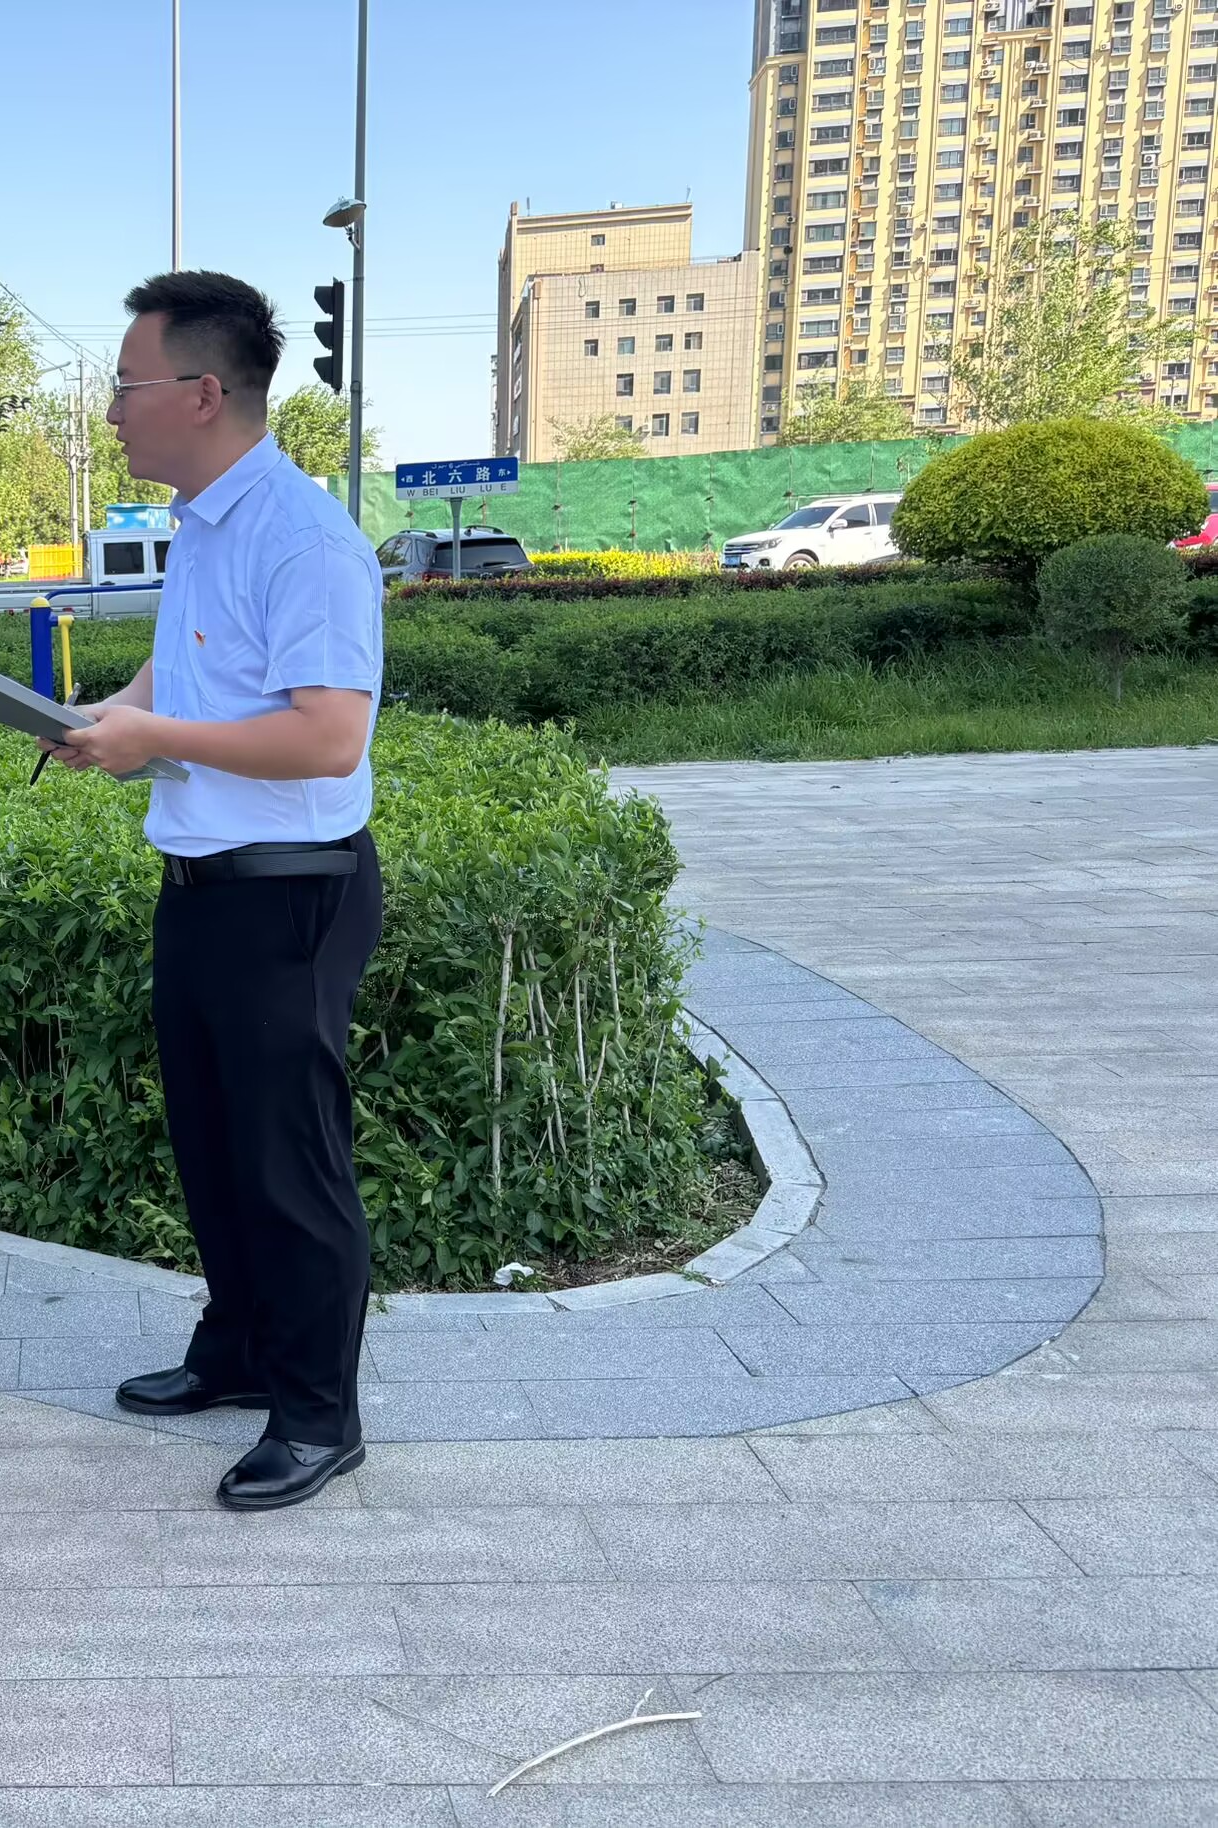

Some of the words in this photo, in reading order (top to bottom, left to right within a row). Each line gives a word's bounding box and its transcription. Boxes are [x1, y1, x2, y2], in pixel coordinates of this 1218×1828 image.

[422, 466, 491, 485] 北六路
[498, 468, 506, 477] 东
[407, 489, 415, 497] W
[422, 488, 439, 497] BEI
[450, 486, 466, 495] LIU
[480, 484, 492, 493] LU
[500, 483, 507, 491] E
